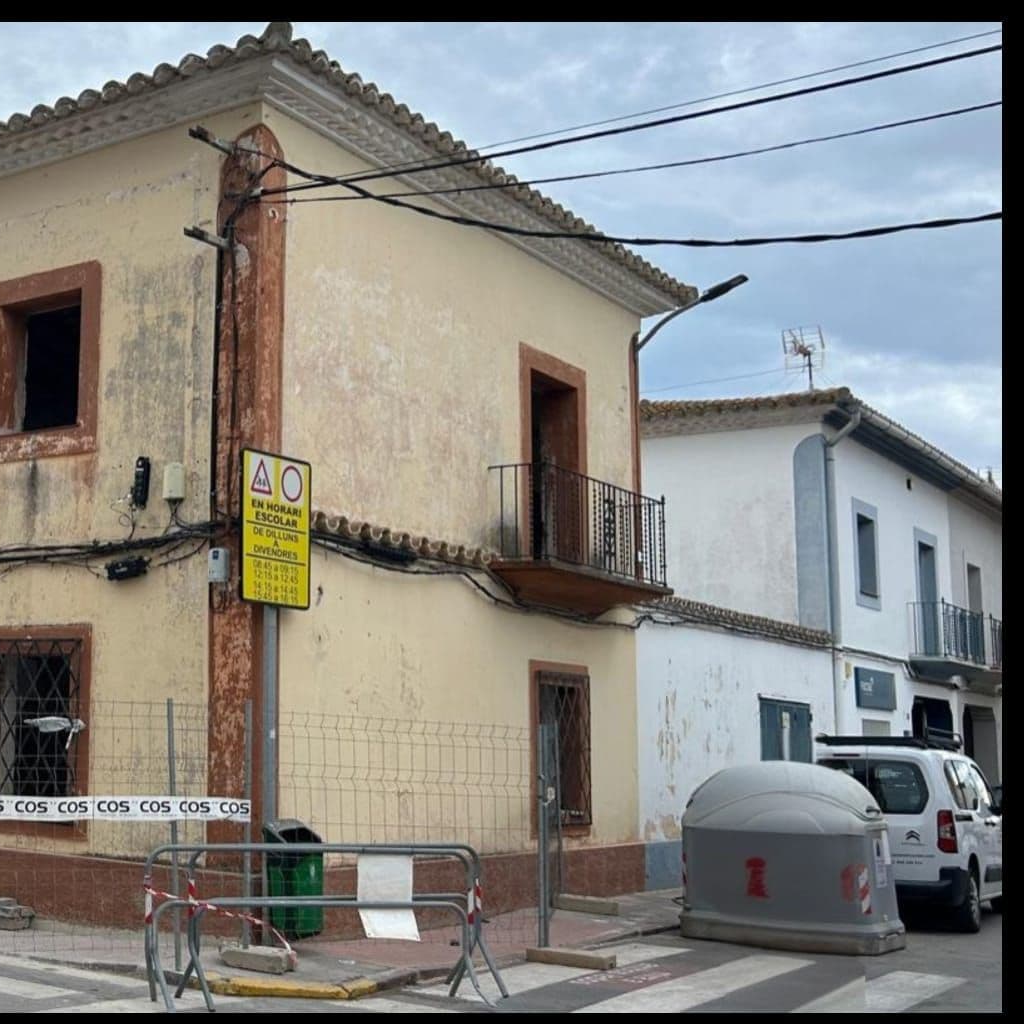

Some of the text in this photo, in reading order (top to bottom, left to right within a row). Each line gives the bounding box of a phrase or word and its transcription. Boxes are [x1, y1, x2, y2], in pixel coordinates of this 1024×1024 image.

[251, 498, 302, 518] EN HORARI
[255, 511, 298, 528] ESCOLAR
[253, 526, 299, 543] DE DILLUNS
[253, 545, 298, 561] DIVENDRES
[14, 800, 48, 813] COS
[57, 801, 88, 814] COS
[97, 800, 130, 813] COS
[139, 800, 171, 813] COS
[179, 800, 211, 814] COS
[219, 801, 250, 815] COS
